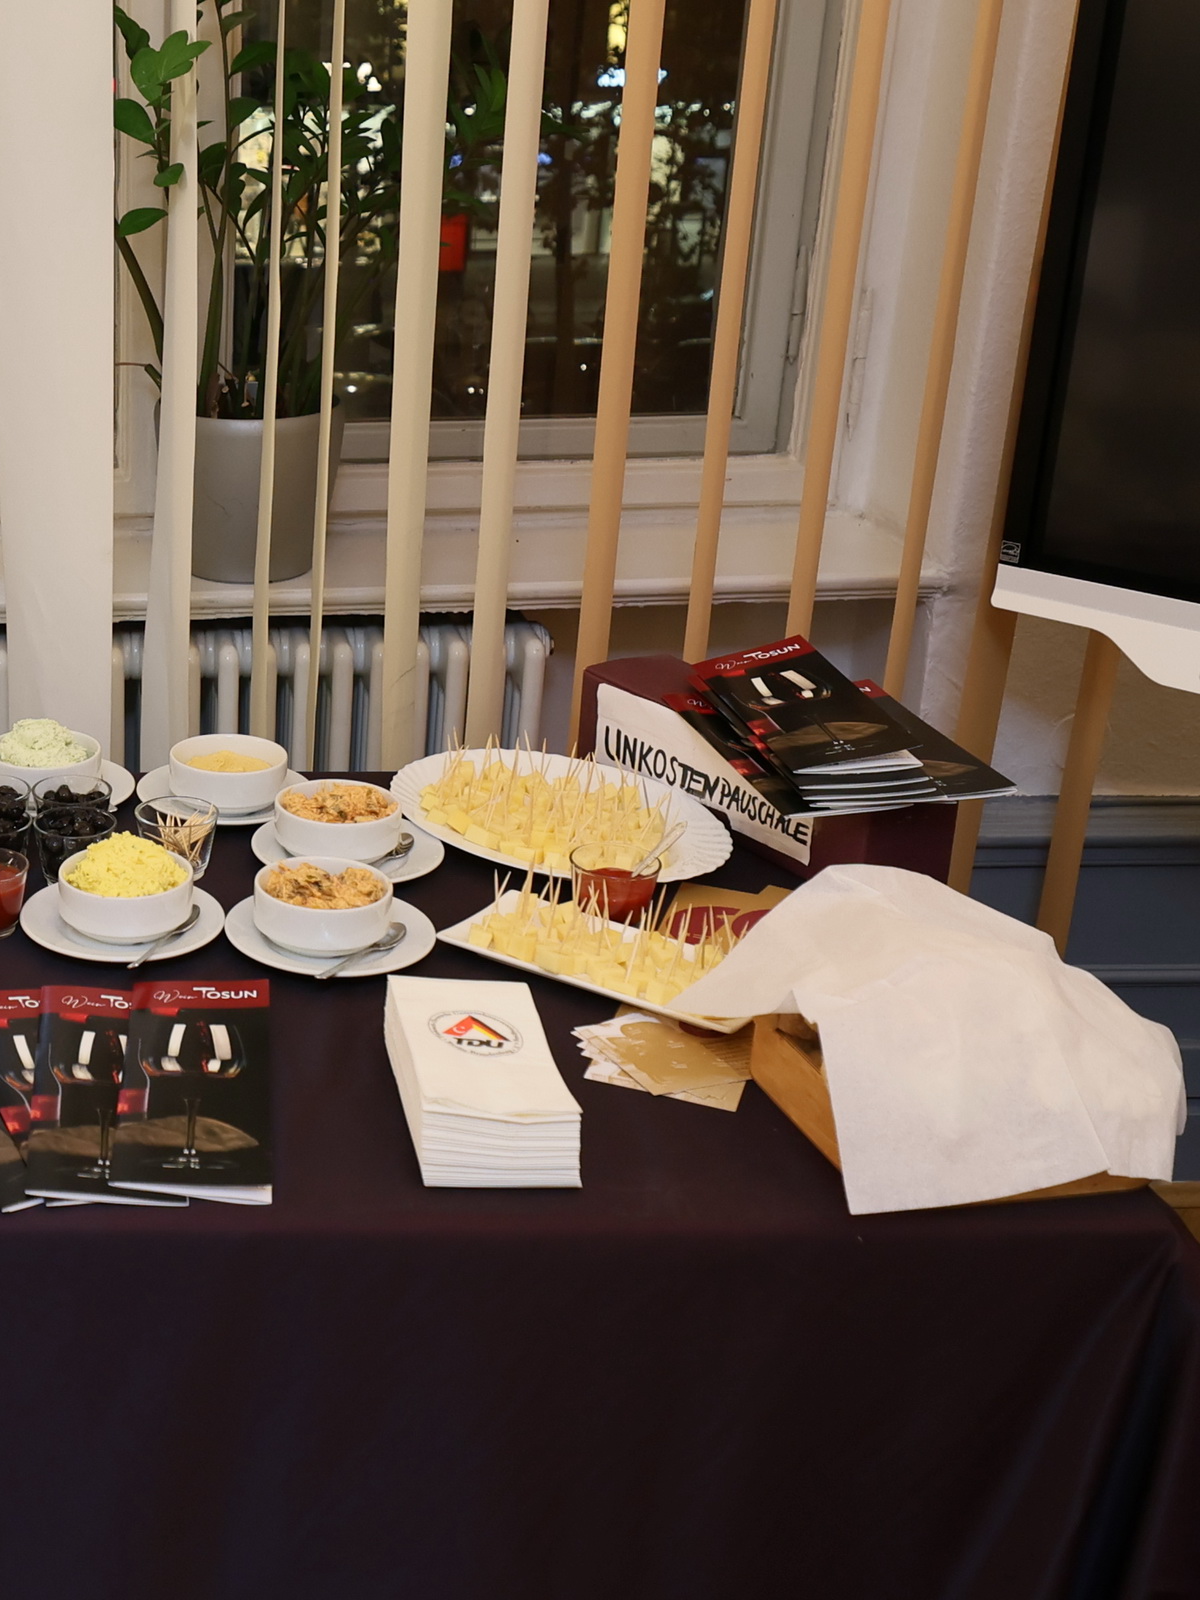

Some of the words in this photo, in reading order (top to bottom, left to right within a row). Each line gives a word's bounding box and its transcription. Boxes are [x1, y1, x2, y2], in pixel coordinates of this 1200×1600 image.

[192, 986, 258, 999] TOSUN
[8, 996, 40, 1008] TO
[100, 994, 133, 1010] TO
